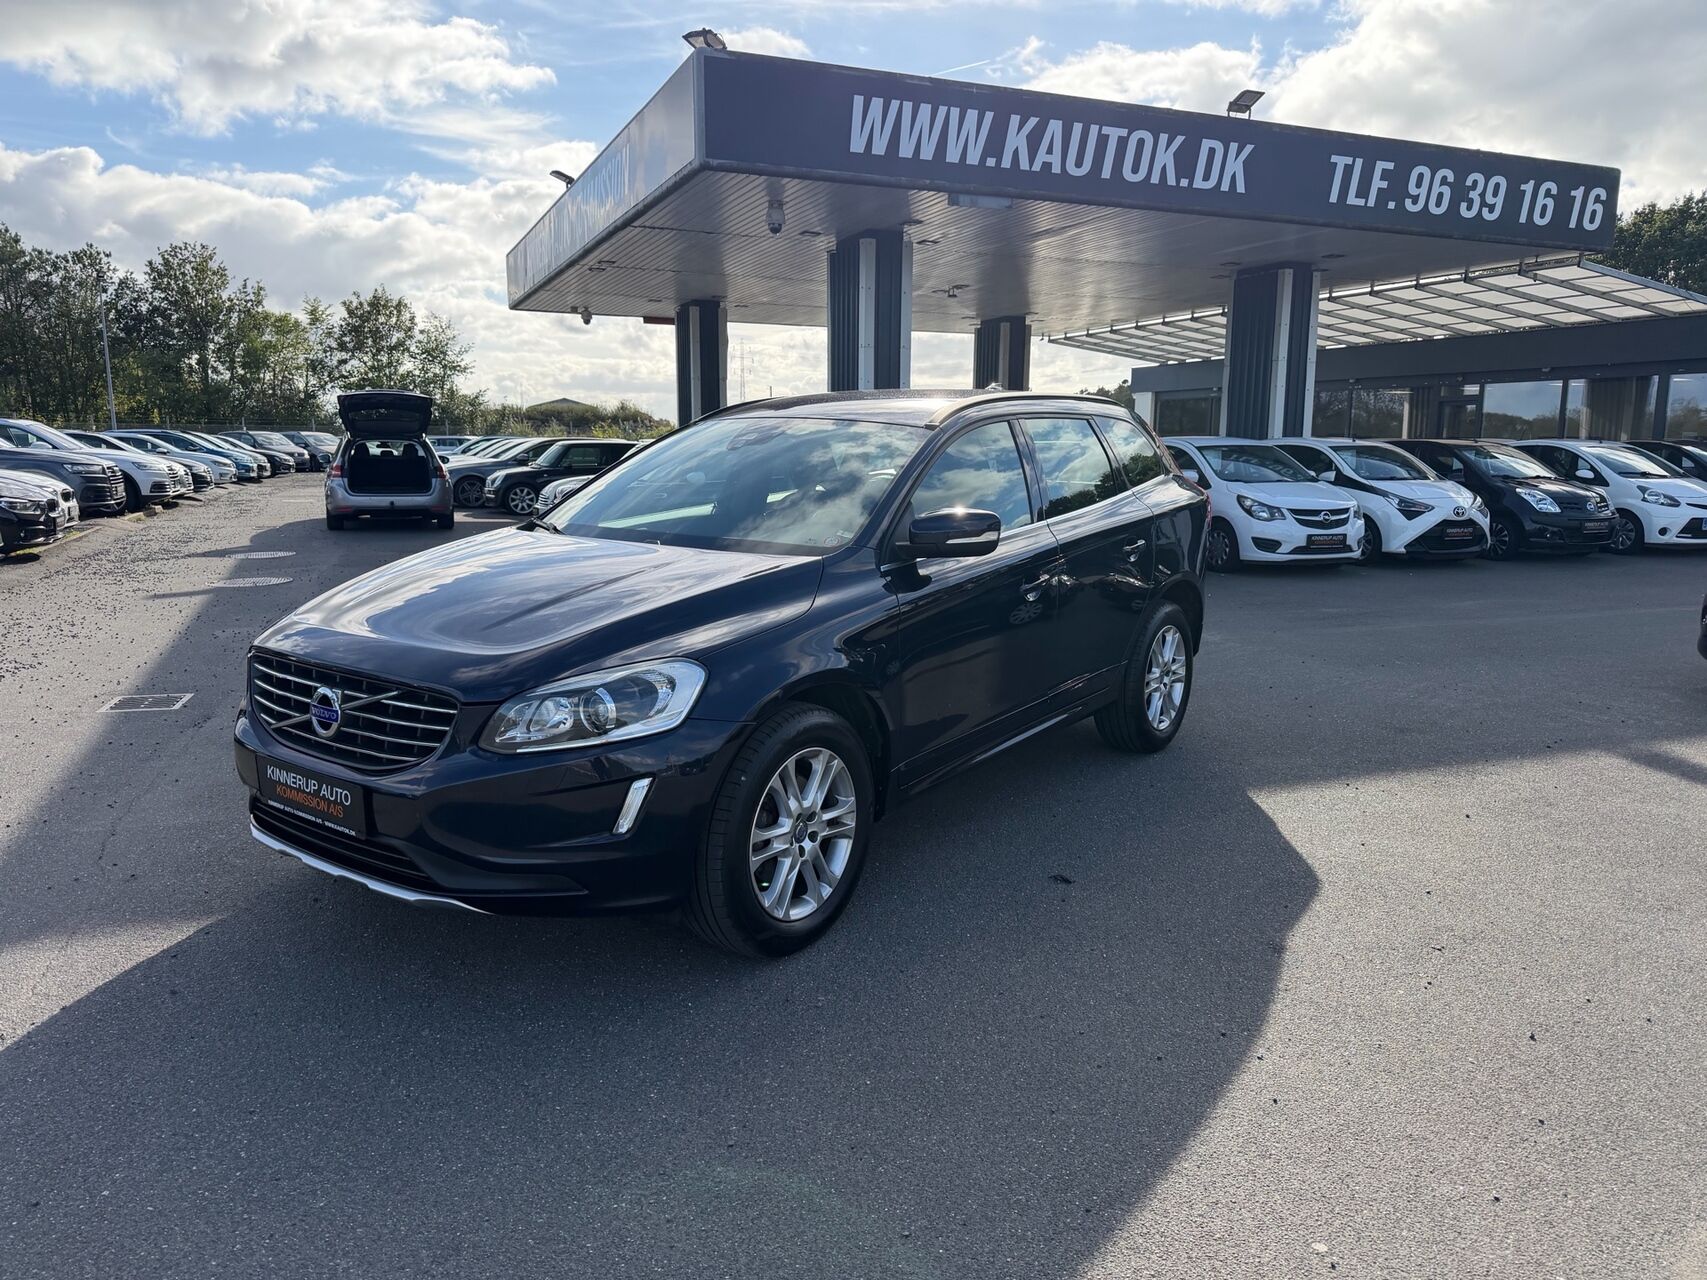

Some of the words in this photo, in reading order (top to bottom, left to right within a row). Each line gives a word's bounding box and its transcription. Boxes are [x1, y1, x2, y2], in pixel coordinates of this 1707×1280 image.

[849, 94, 1255, 195] WWW.KAUTOK.DK
[1328, 154, 1396, 211] TLF.
[1405, 165, 1455, 215] 96
[1459, 172, 1507, 221] 39
[1519, 179, 1558, 226] 16
[1568, 185, 1607, 231] 16
[311, 706, 337, 720] VOLVO
[267, 765, 318, 793] KINNERUP
[320, 783, 351, 805] AUTO
[276, 784, 328, 813] KOMMISSION
[329, 804, 344, 818] A/S
